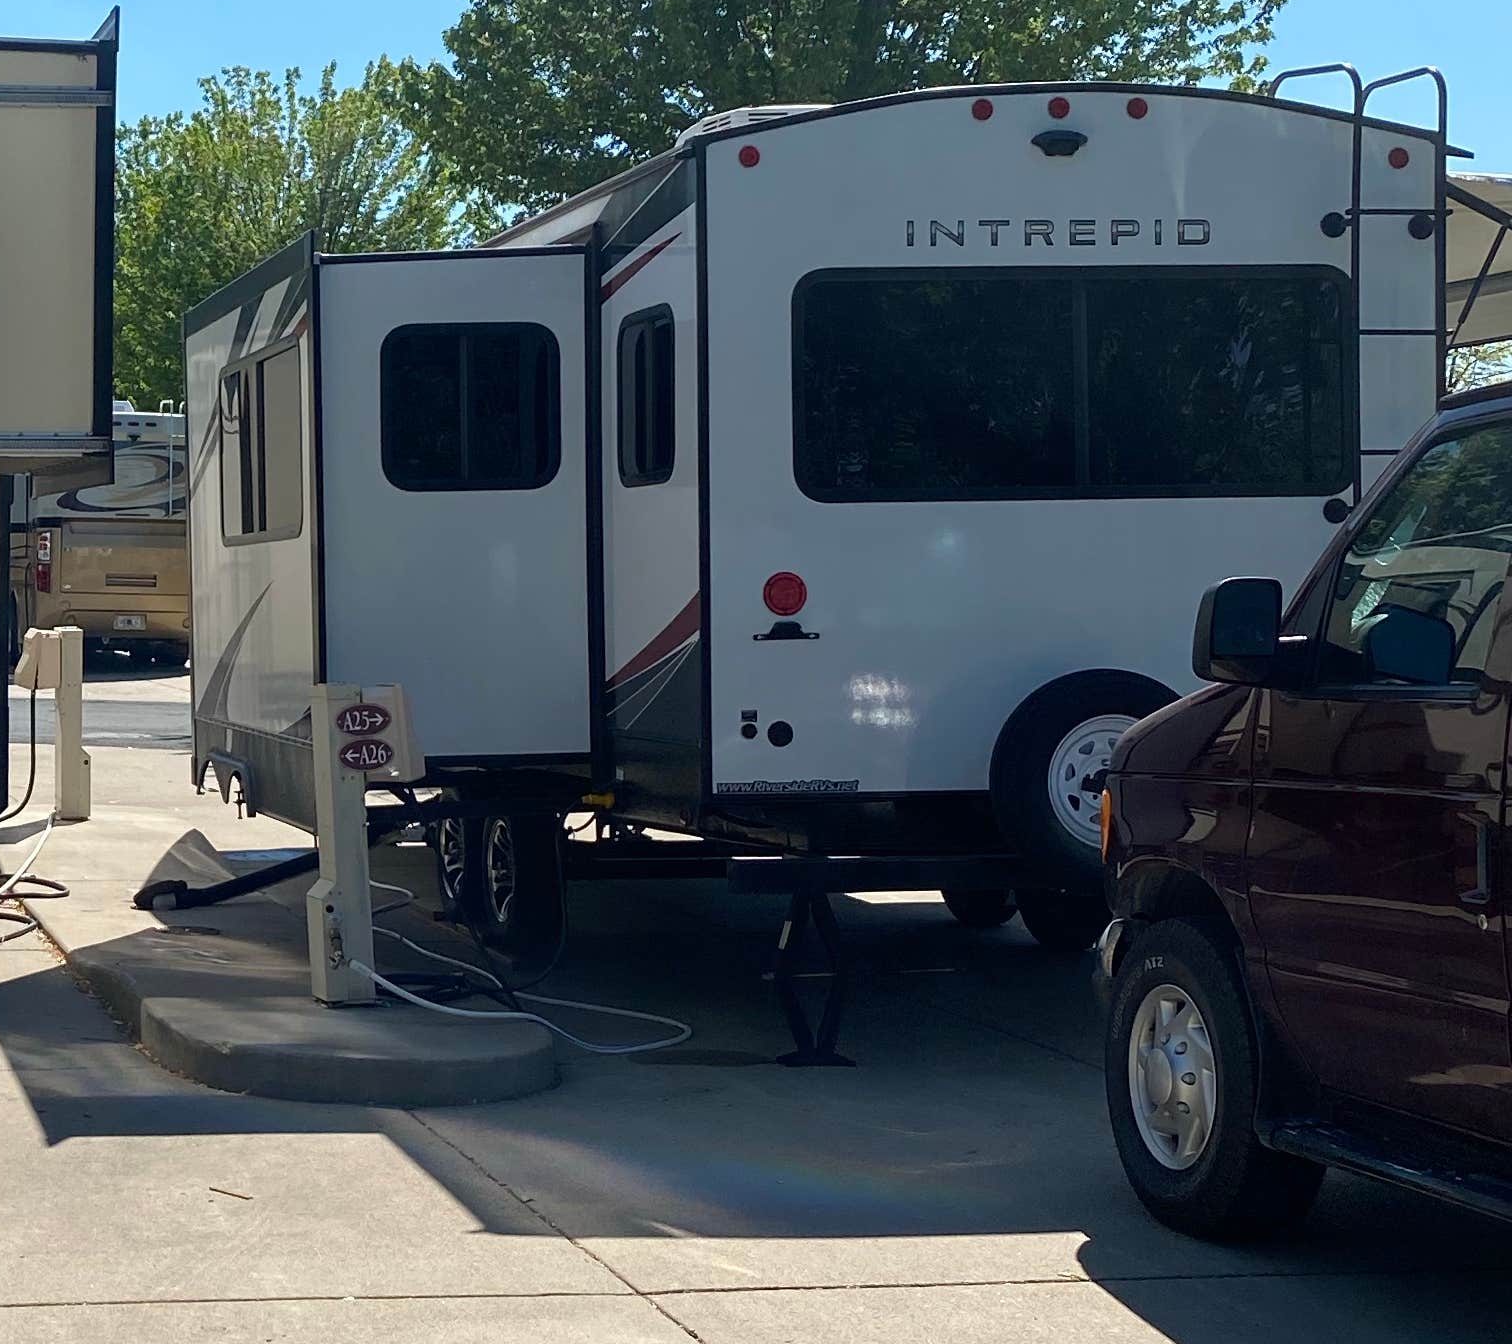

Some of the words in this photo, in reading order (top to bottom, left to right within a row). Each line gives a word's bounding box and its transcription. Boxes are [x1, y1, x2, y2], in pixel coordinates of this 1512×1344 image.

[906, 219, 1211, 247] INTREPID
[343, 710, 370, 732] A25
[359, 744, 387, 765] A26
[717, 779, 859, 793] www.RiversideRVs.net
